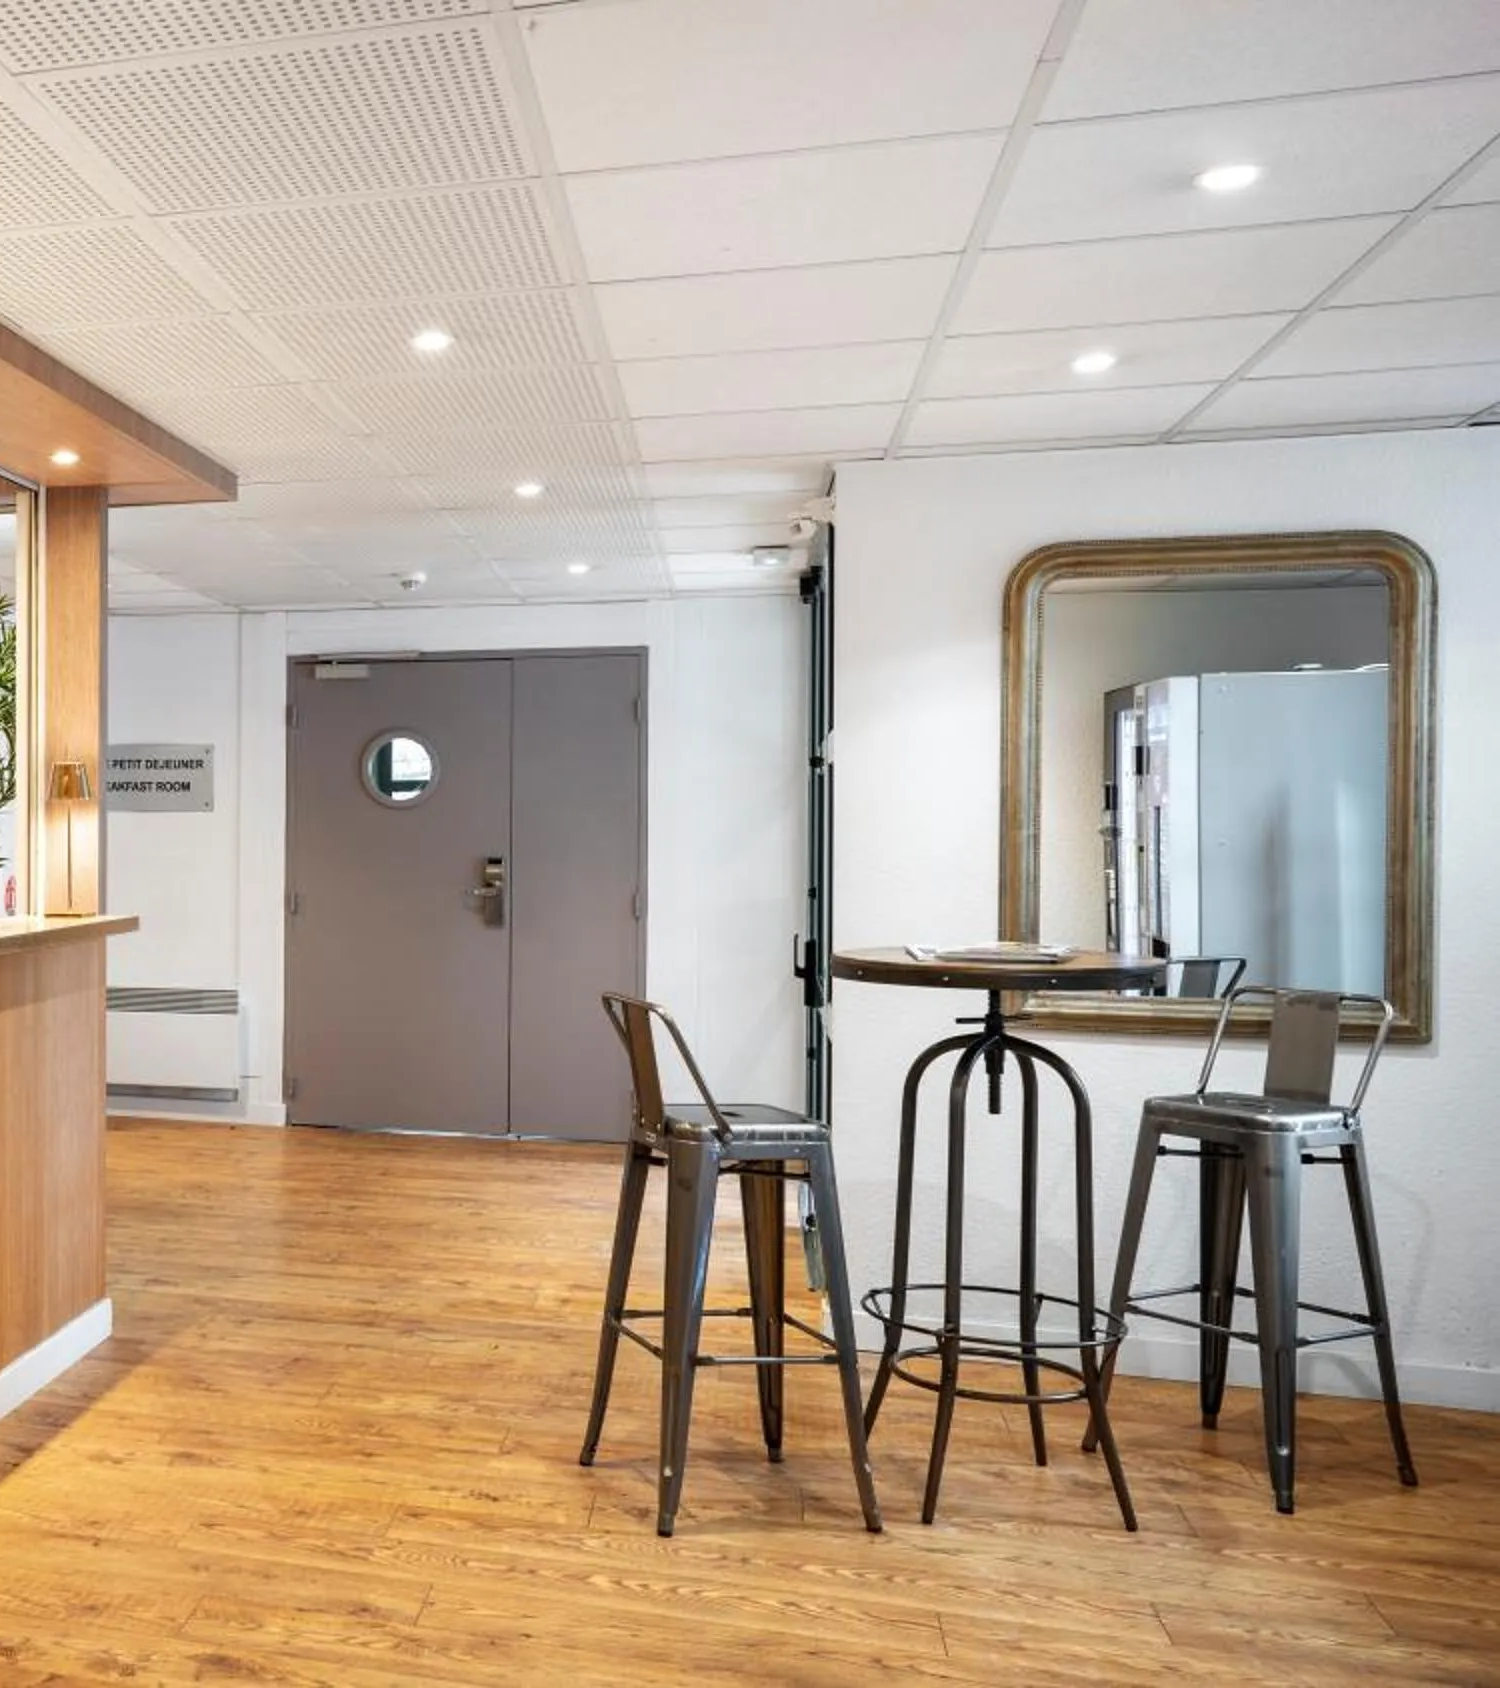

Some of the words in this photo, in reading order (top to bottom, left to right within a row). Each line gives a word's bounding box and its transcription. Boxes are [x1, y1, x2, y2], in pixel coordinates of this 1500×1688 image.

[112, 759, 142, 769] PETIT
[145, 759, 204, 769] DEJEUNER
[156, 781, 191, 792] ROOM
